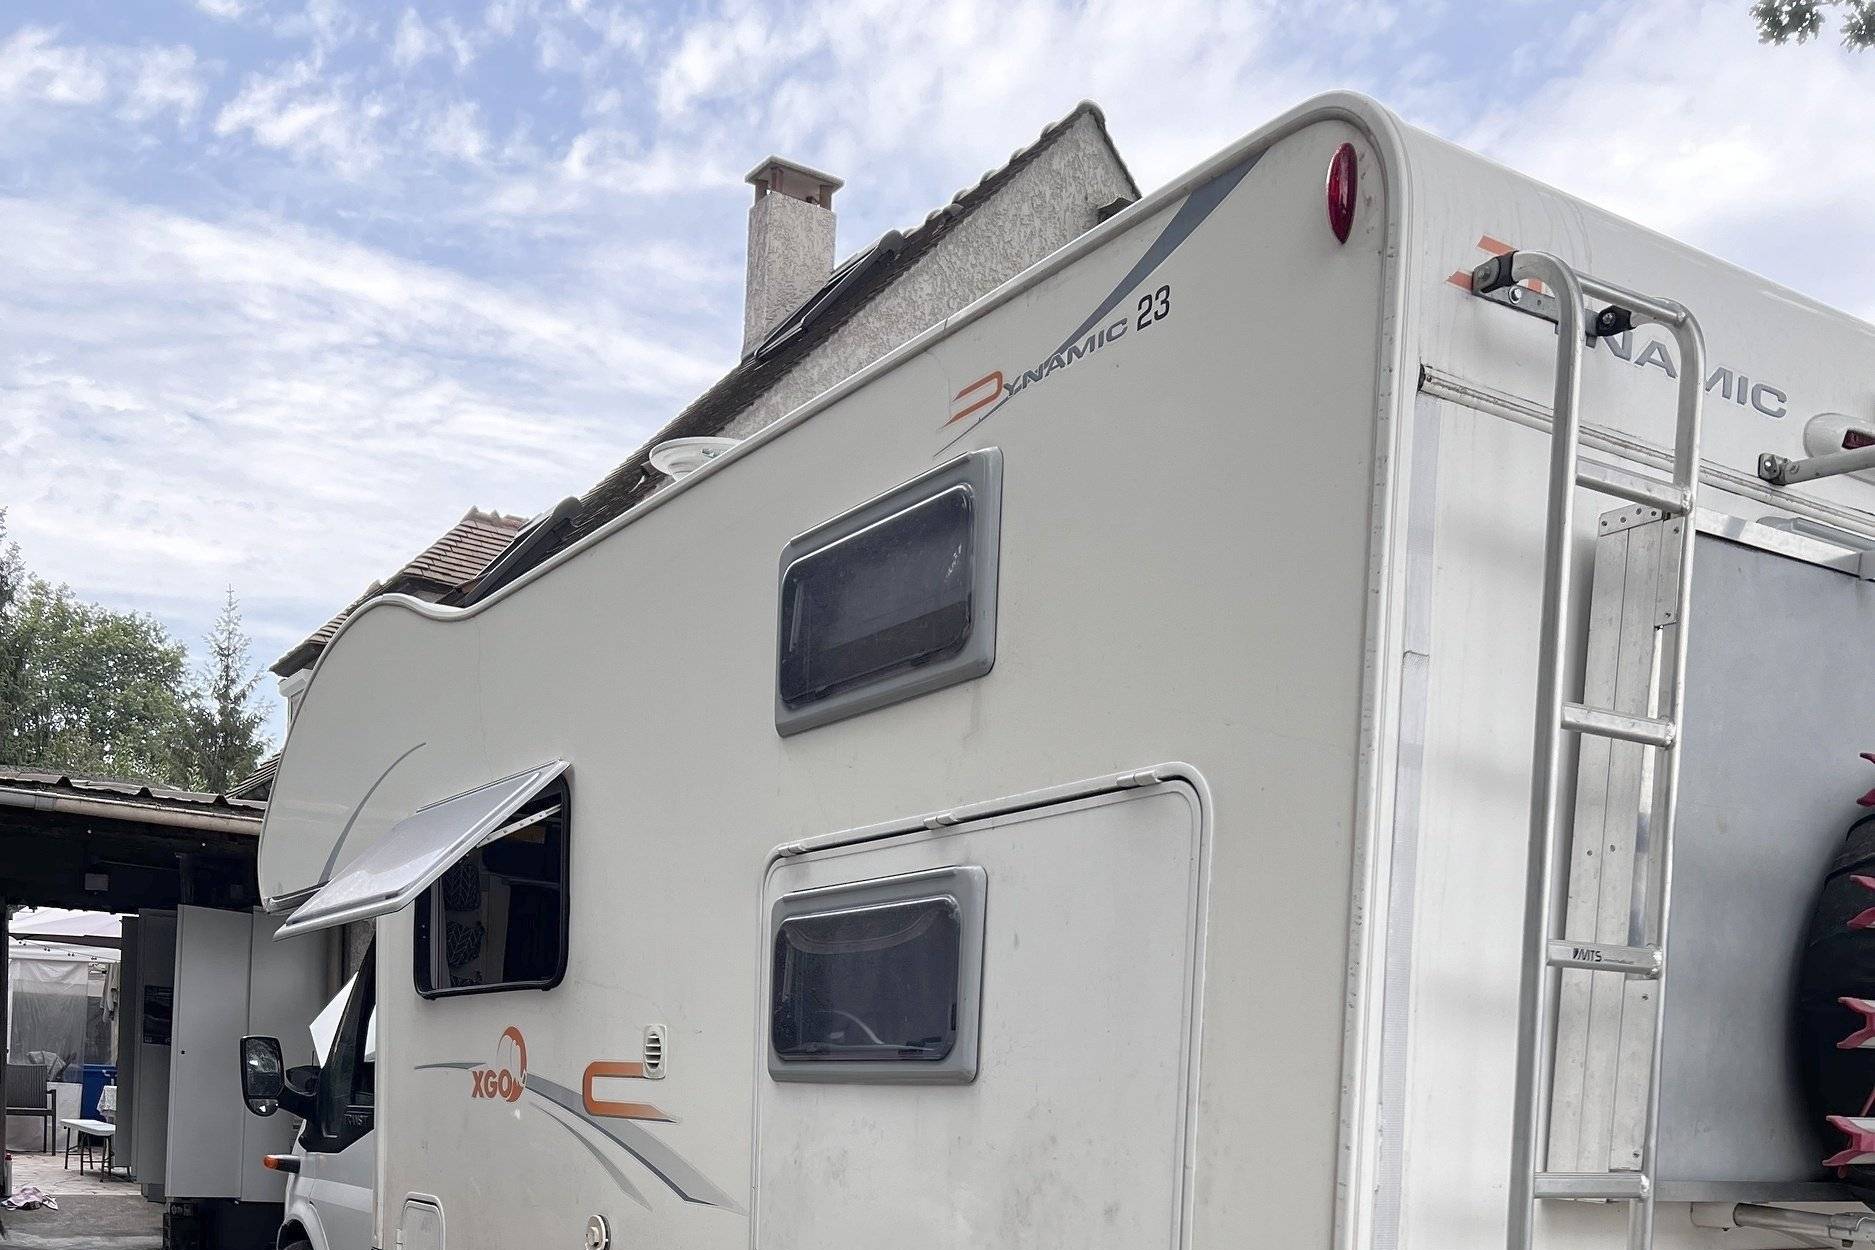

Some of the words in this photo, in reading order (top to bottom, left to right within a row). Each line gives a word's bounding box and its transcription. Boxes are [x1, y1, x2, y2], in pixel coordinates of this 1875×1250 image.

[941, 318, 1128, 428] DYNAMIC
[1136, 284, 1171, 332] 23
[471, 1068, 513, 1099] XGO
